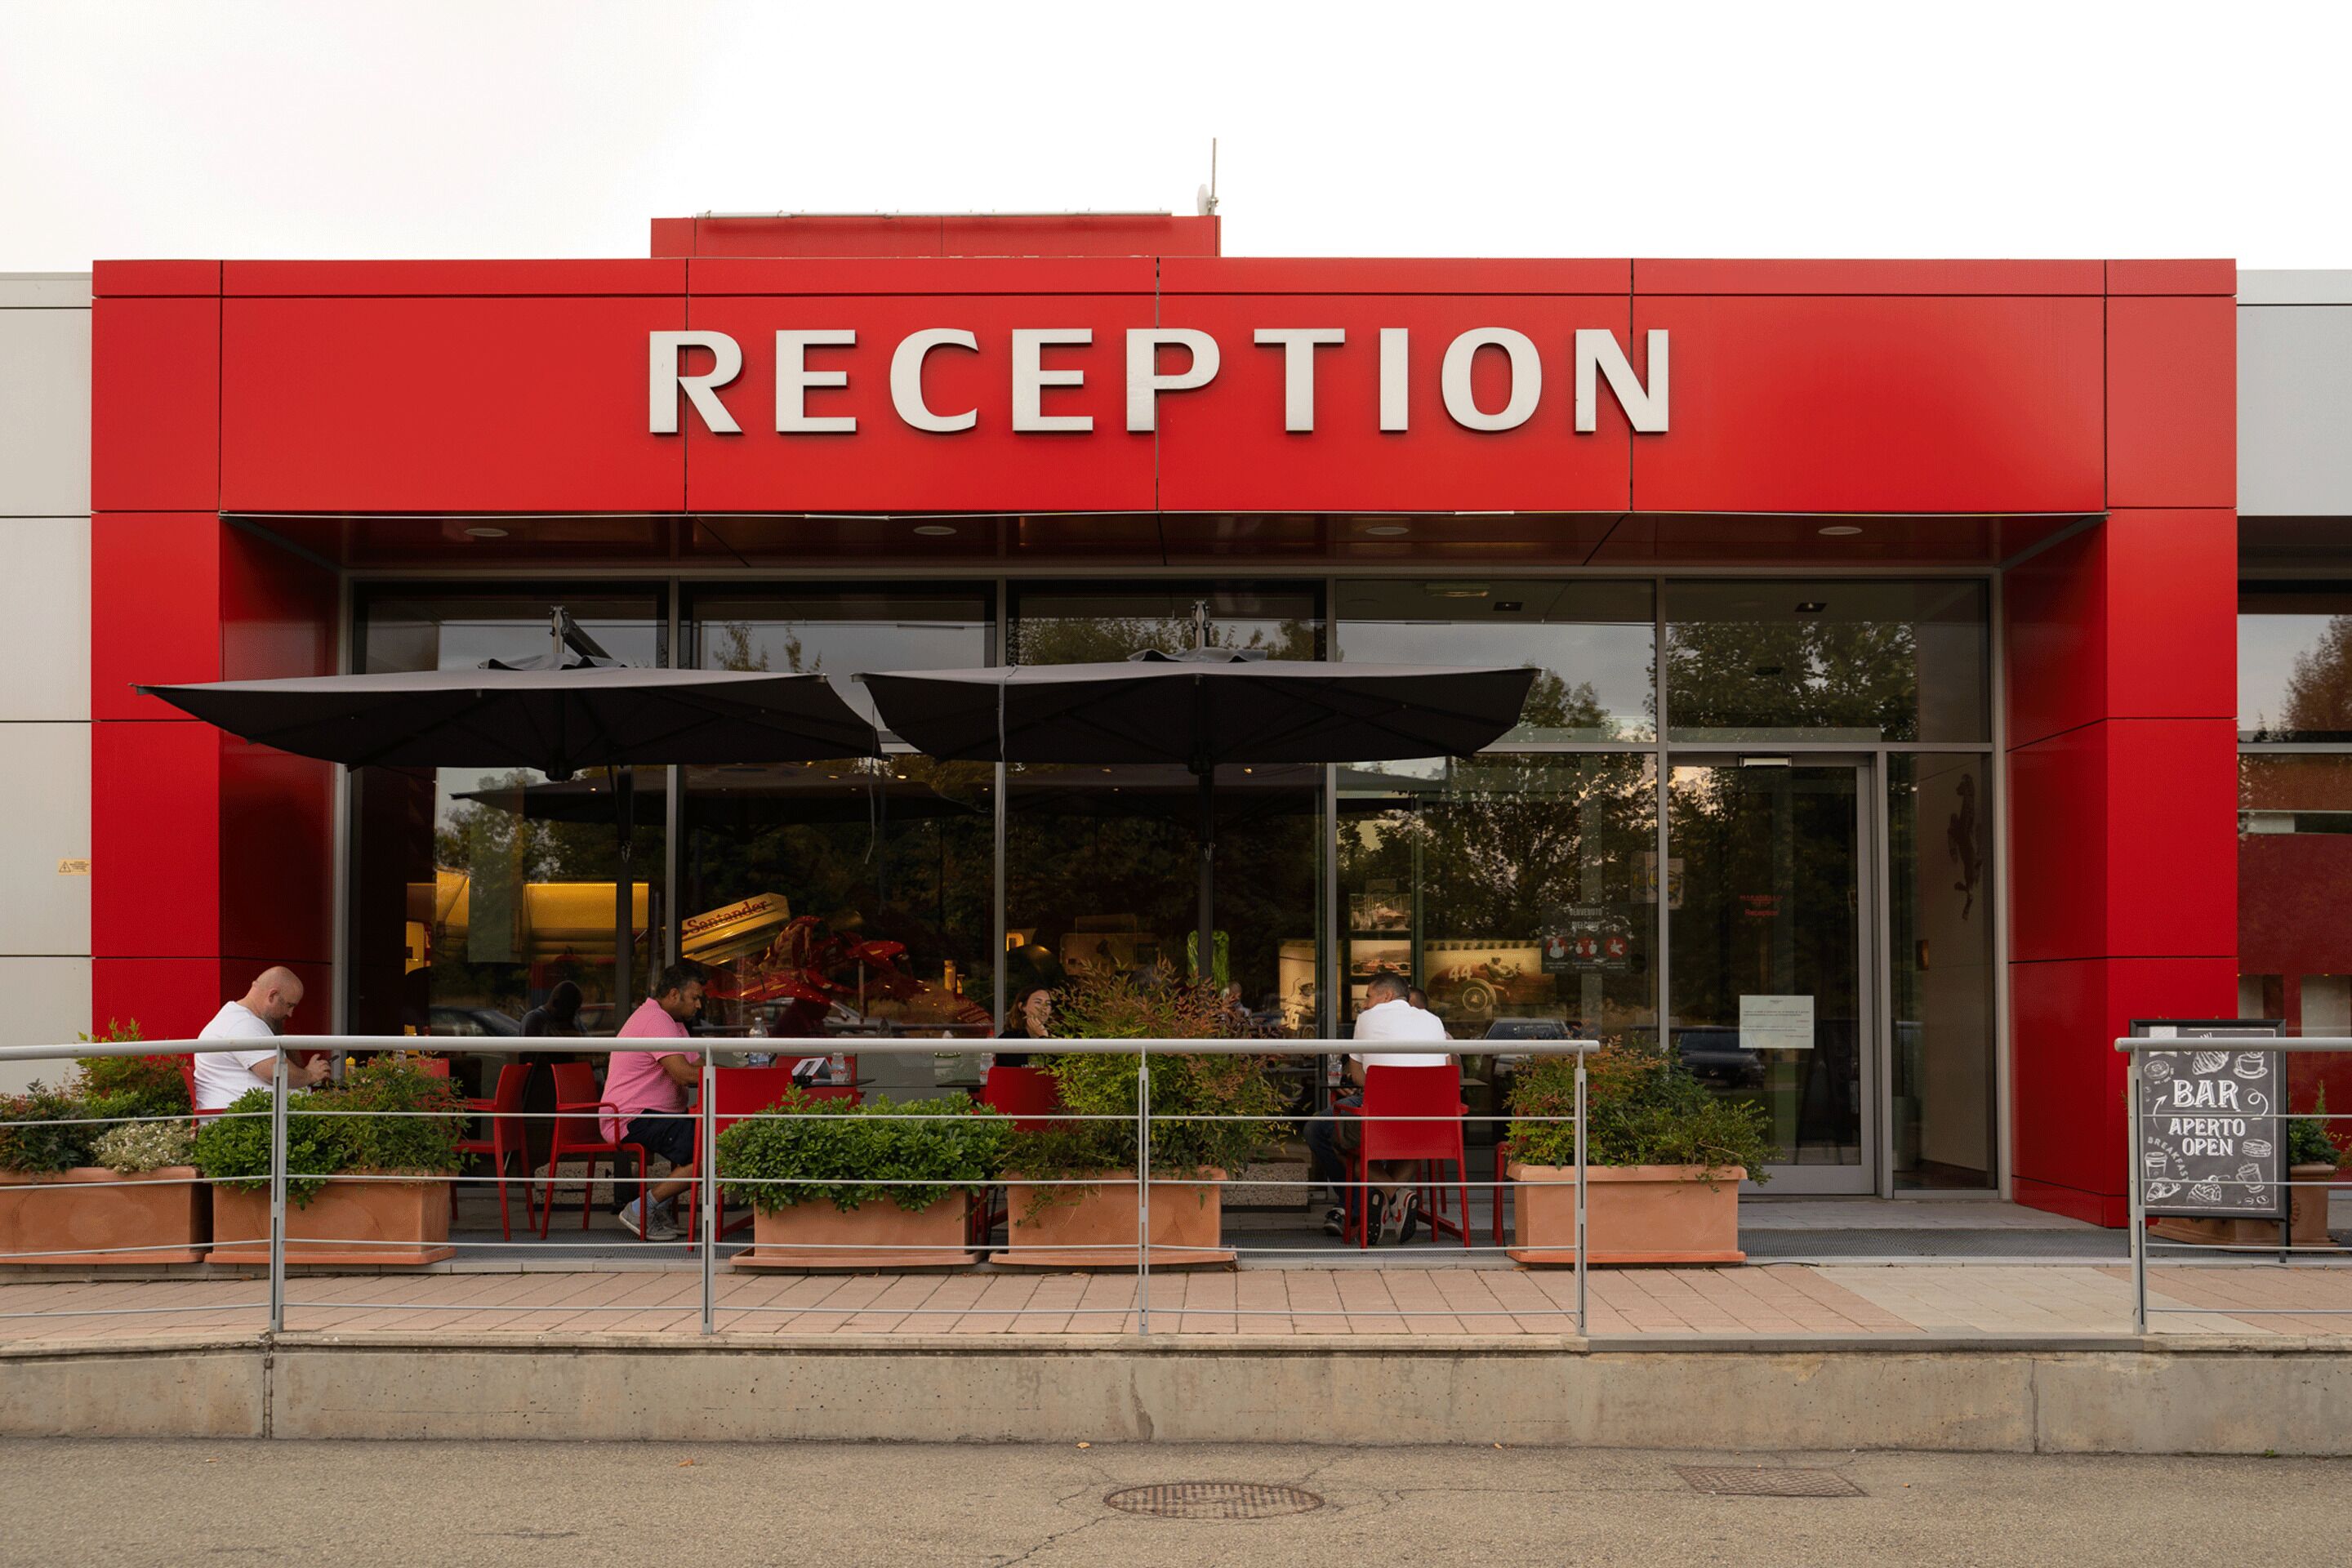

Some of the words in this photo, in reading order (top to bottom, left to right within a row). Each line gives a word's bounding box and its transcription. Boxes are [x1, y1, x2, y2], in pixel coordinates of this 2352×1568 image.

[649, 327, 1670, 434] RECEPTION
[687, 901, 768, 934] Santander
[1449, 966, 1472, 982] 44
[2172, 1080, 2240, 1111] BAR
[2168, 1118, 2246, 1138] APERTO
[2147, 1136, 2189, 1181] BREAKFAST
[2181, 1138, 2234, 1156] OPEN
